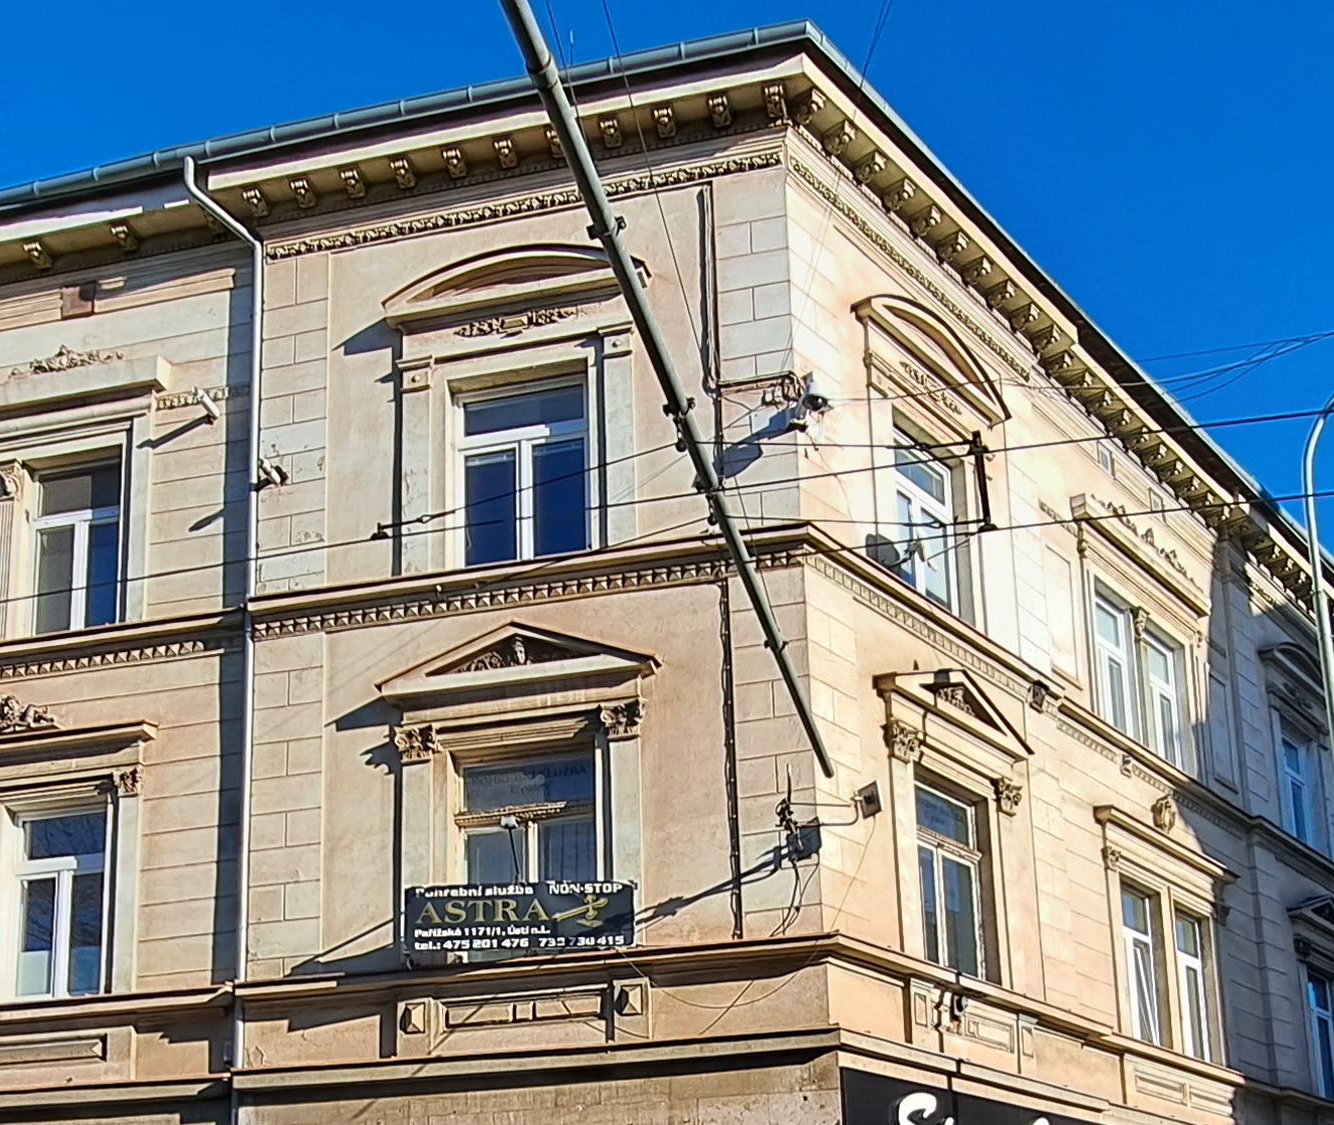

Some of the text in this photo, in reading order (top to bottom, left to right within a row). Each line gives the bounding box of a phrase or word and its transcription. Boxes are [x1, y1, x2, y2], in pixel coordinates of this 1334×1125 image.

[417, 899, 550, 924] ASTRA
[442, 940, 471, 950] 475
[472, 939, 498, 948] 201
[501, 938, 529, 948] 476
[597, 935, 624, 945] 415
